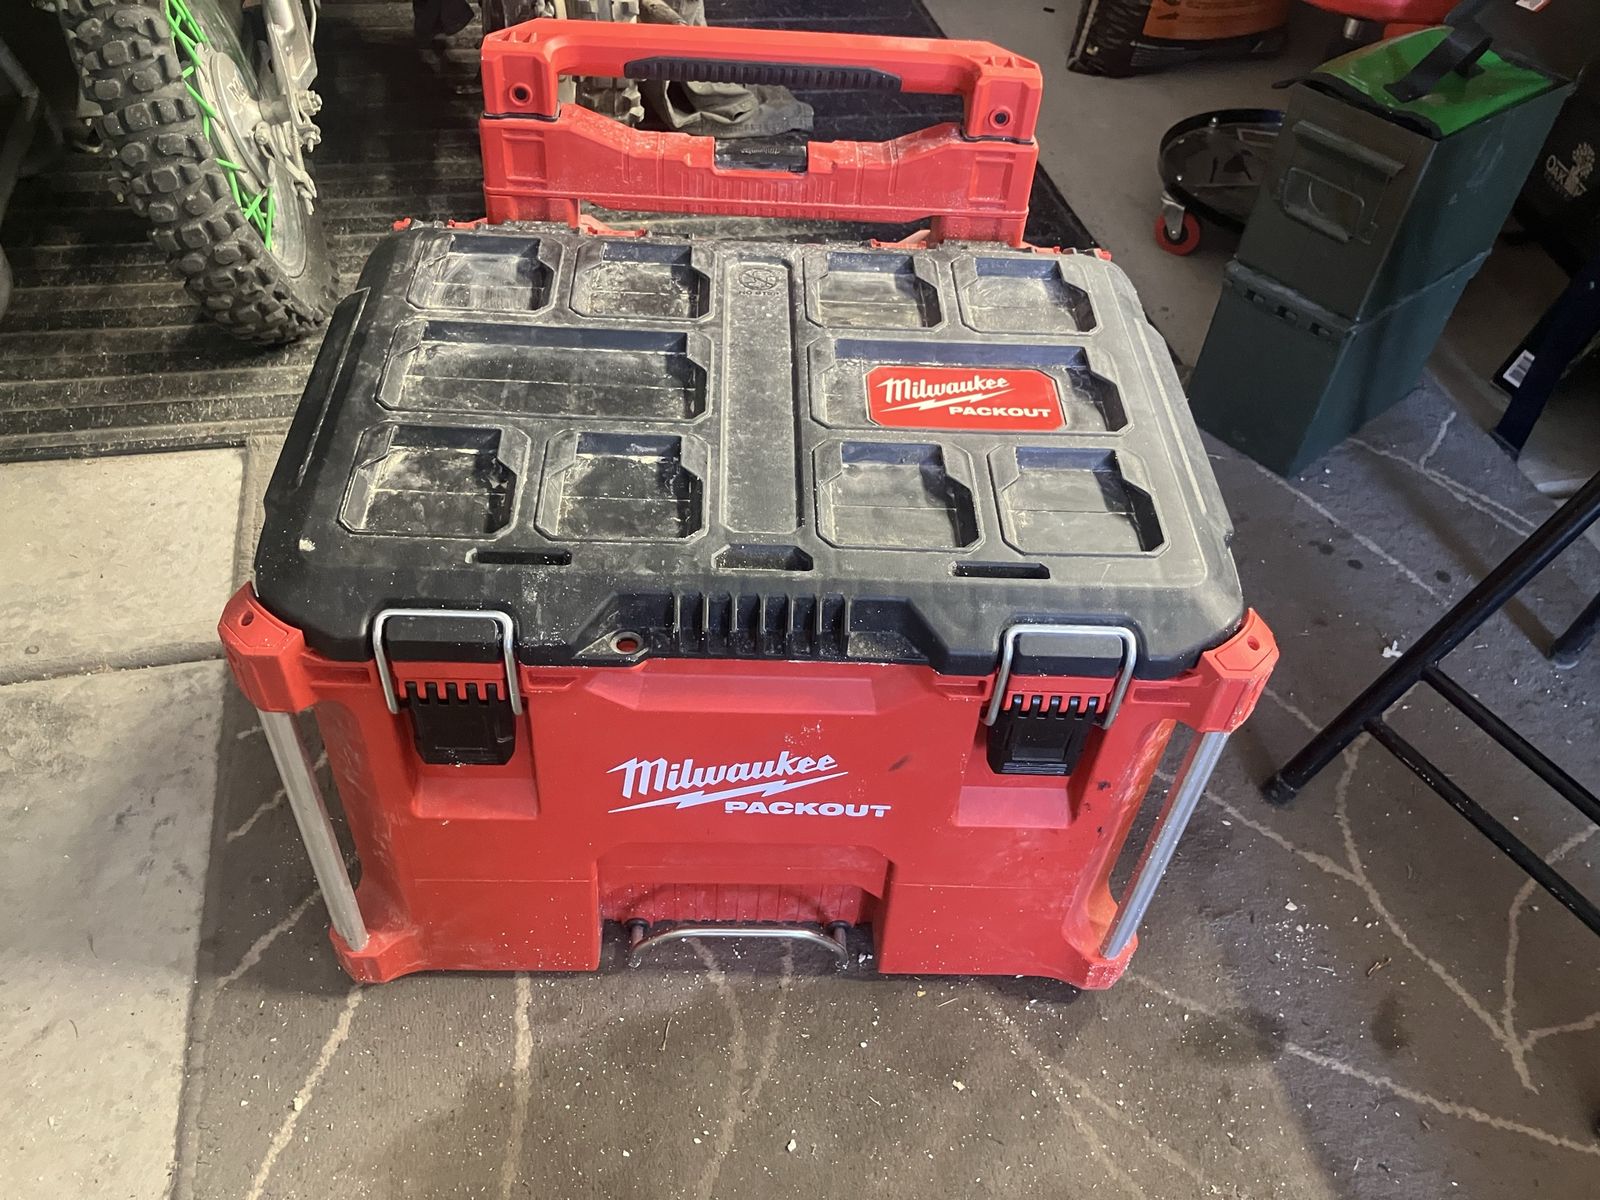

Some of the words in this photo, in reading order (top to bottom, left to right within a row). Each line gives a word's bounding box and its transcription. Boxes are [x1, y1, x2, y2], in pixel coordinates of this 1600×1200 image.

[876, 375, 1010, 404] Milwaukee
[949, 406, 1051, 418] PACKOUT
[606, 751, 838, 799] Milwaukee
[724, 801, 892, 817] PACKOUT
